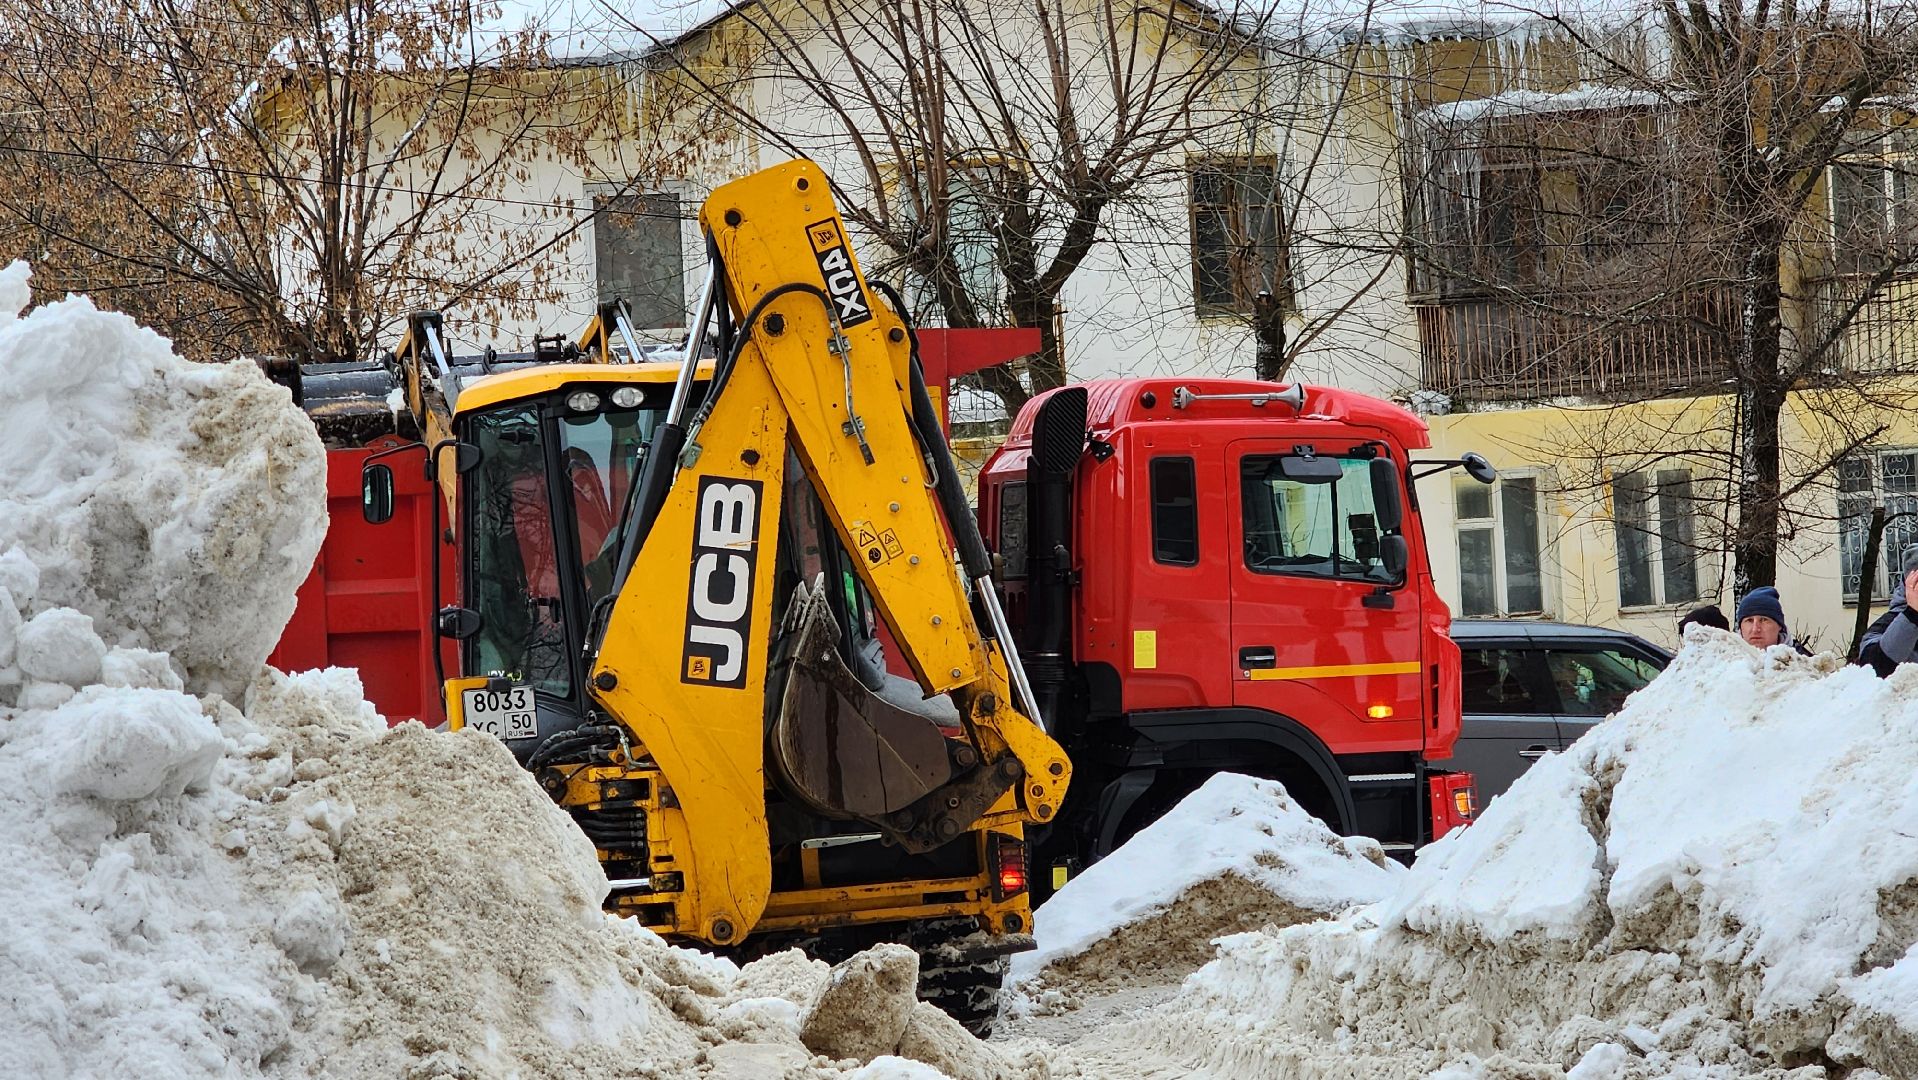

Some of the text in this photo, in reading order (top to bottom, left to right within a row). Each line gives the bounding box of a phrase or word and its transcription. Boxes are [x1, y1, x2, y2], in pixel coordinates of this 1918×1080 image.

[816, 230, 834, 244] JCB
[822, 248, 868, 319] 4CX
[689, 483, 756, 682] JCB
[473, 690, 526, 713] 8033
[511, 713, 532, 730] 50
